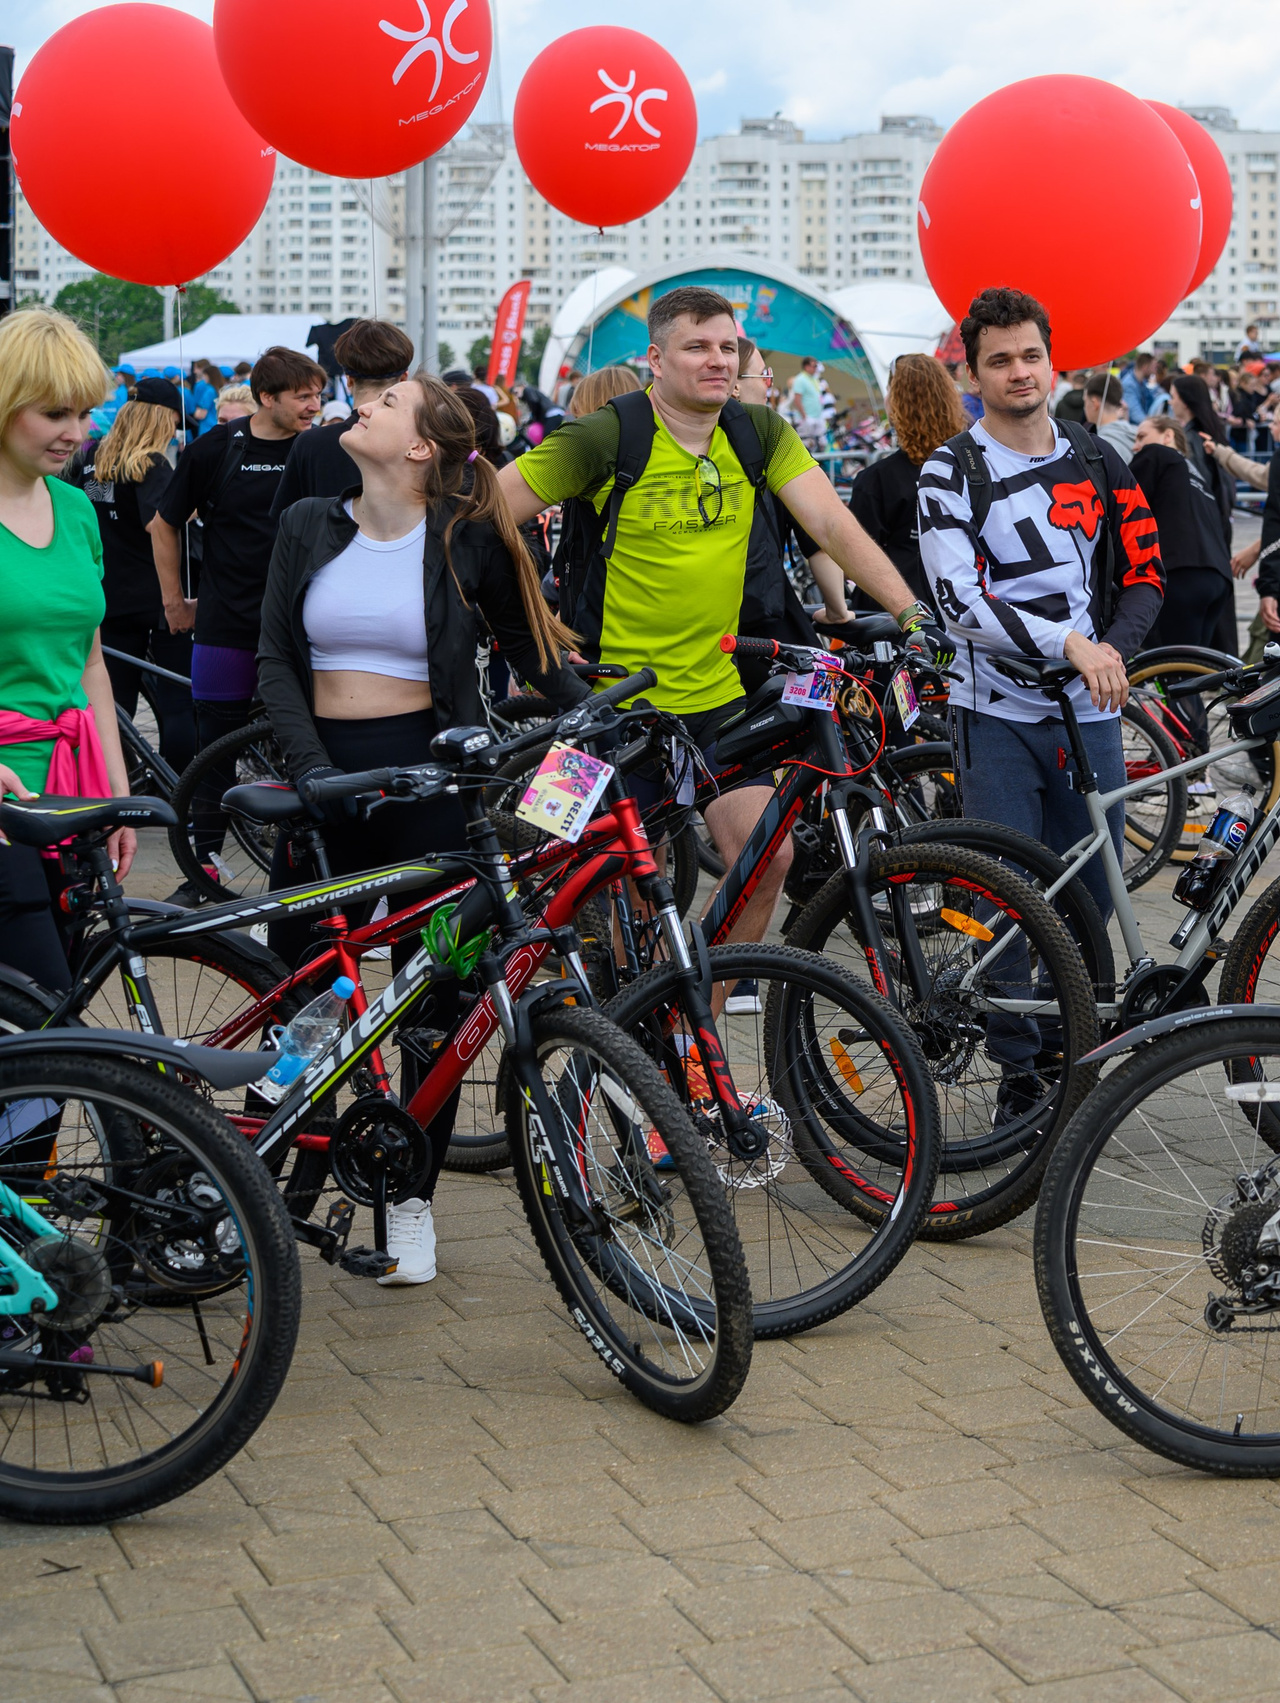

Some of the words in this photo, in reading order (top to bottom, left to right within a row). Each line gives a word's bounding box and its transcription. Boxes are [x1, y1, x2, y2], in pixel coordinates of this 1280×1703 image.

[399, 72, 481, 126] MEGATOP
[584, 142, 660, 152] MEGATOP
[653, 514, 737, 531] FASER
[789, 686, 807, 696] 3208
[560, 800, 582, 833] 11739
[287, 873, 402, 913] NAVIGATOR
[304, 946, 436, 1098] STELS
[1174, 1008, 1233, 1025] colorado
[1067, 1319, 1138, 1415] MAXXIS
